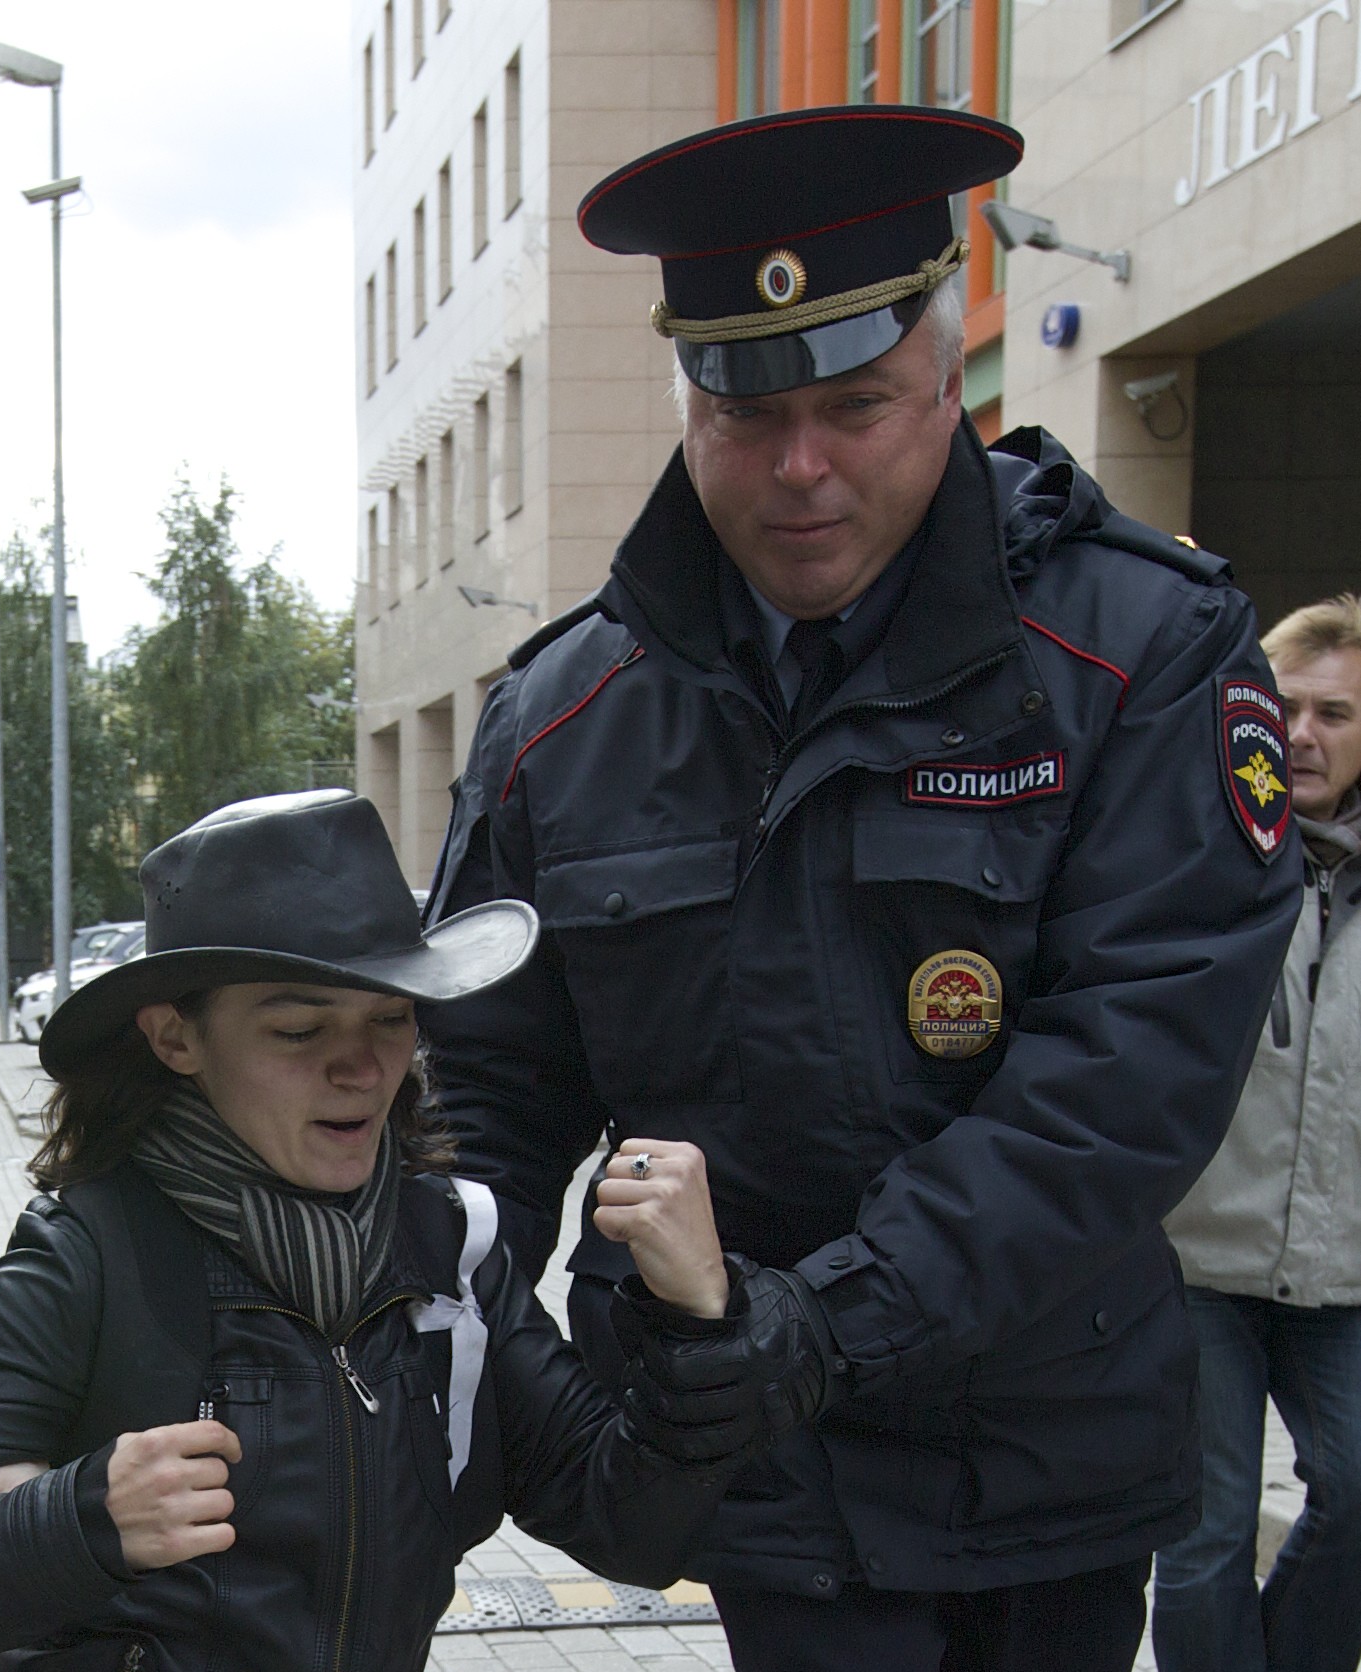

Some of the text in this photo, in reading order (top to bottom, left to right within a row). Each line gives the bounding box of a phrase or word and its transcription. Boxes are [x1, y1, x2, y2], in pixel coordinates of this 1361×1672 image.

[1175, 0, 1361, 207] ЛЕГ
[1227, 687, 1281, 722] ПОЛИЦИЯ
[1232, 722, 1284, 761] РОССИЯ
[916, 760, 1055, 797] ПОЛИЦИЯ
[1252, 822, 1277, 851] МВД
[921, 1021, 987, 1033] ПОЛИЦИЯ
